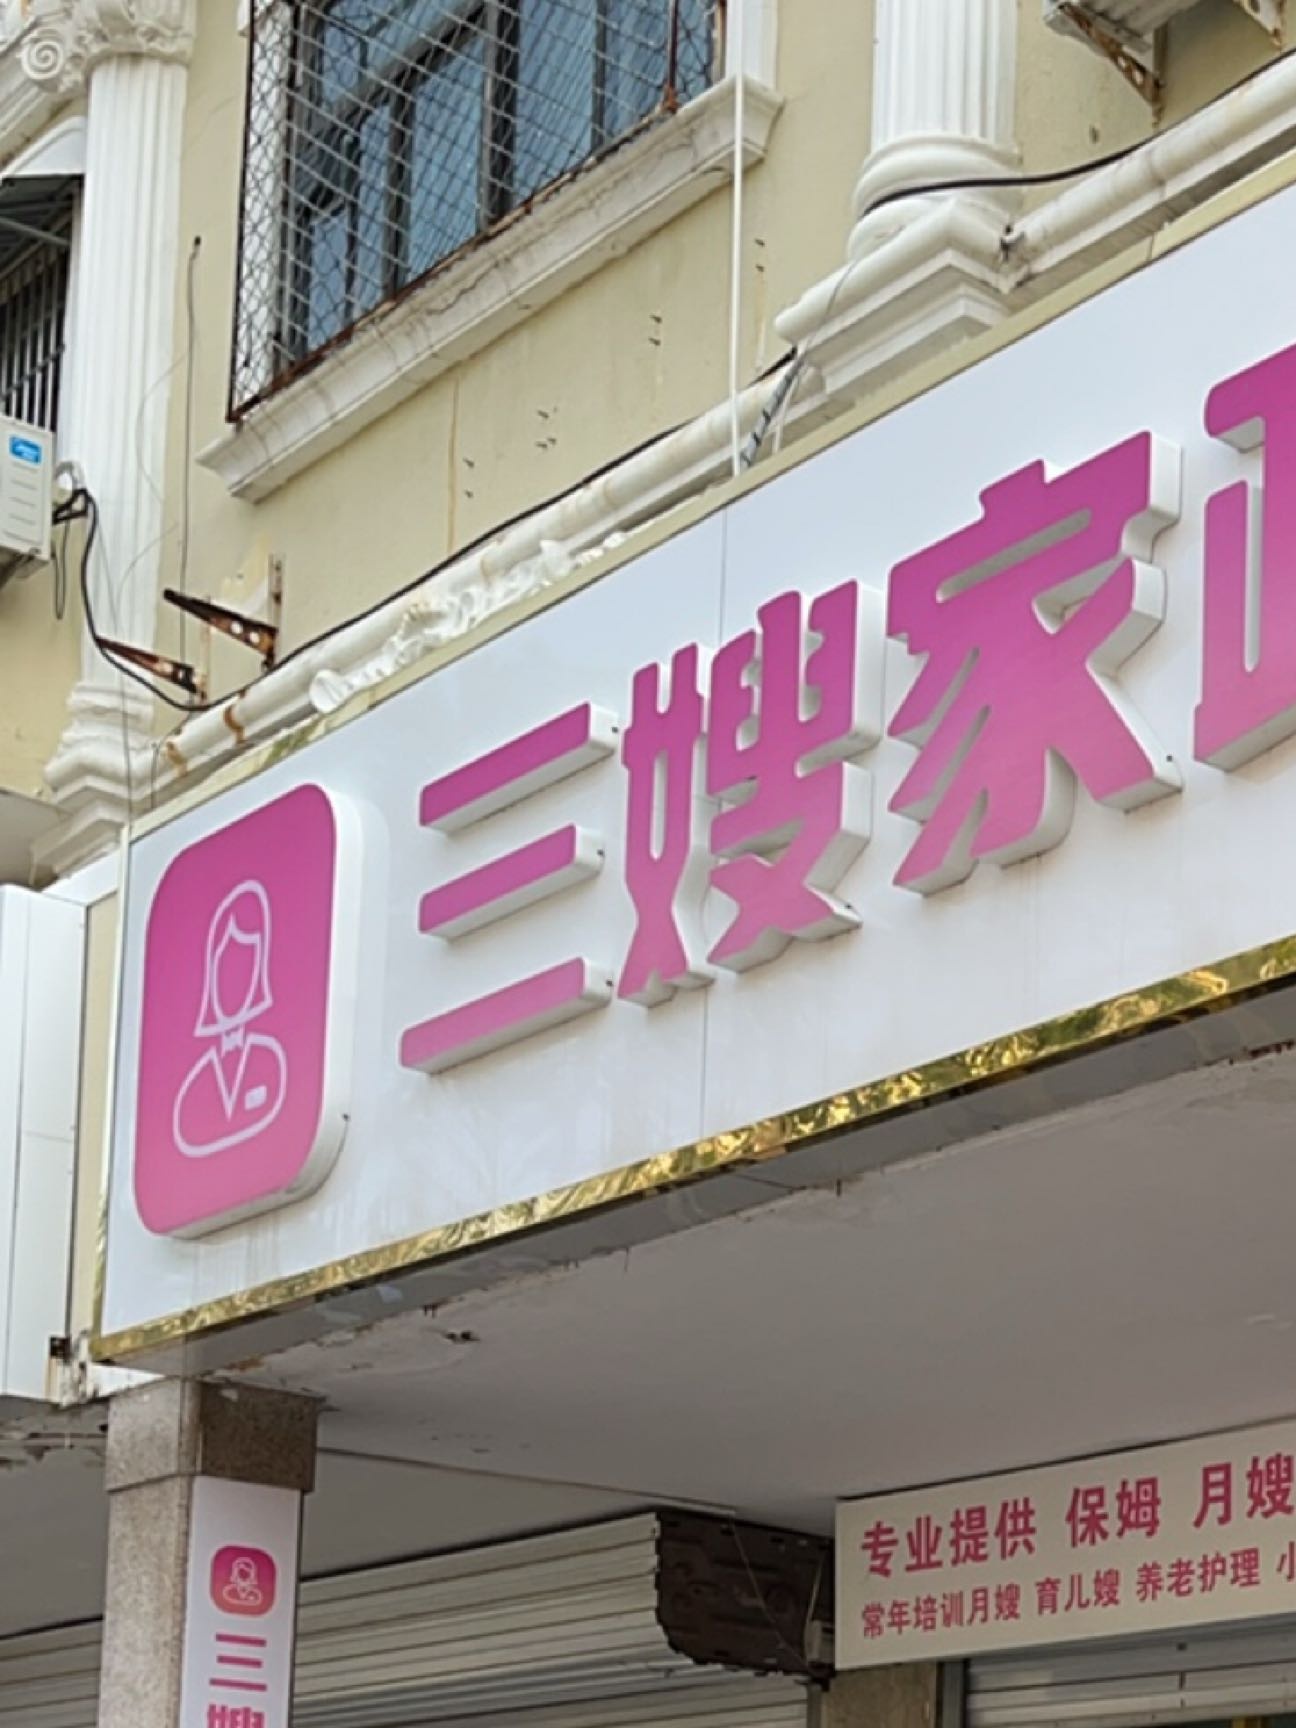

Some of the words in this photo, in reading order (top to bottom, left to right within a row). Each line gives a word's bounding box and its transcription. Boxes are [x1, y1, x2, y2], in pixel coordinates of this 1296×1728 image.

[861, 1498, 1036, 1578] 专业提供
[1065, 1477, 1162, 1548] 保姆
[1193, 1453, 1295, 1528] 月嫂
[861, 1583, 1021, 1640] 常年培训月嫂
[1035, 1568, 1121, 1615] 育儿嫂
[1135, 1547, 1261, 1602] 养老护理
